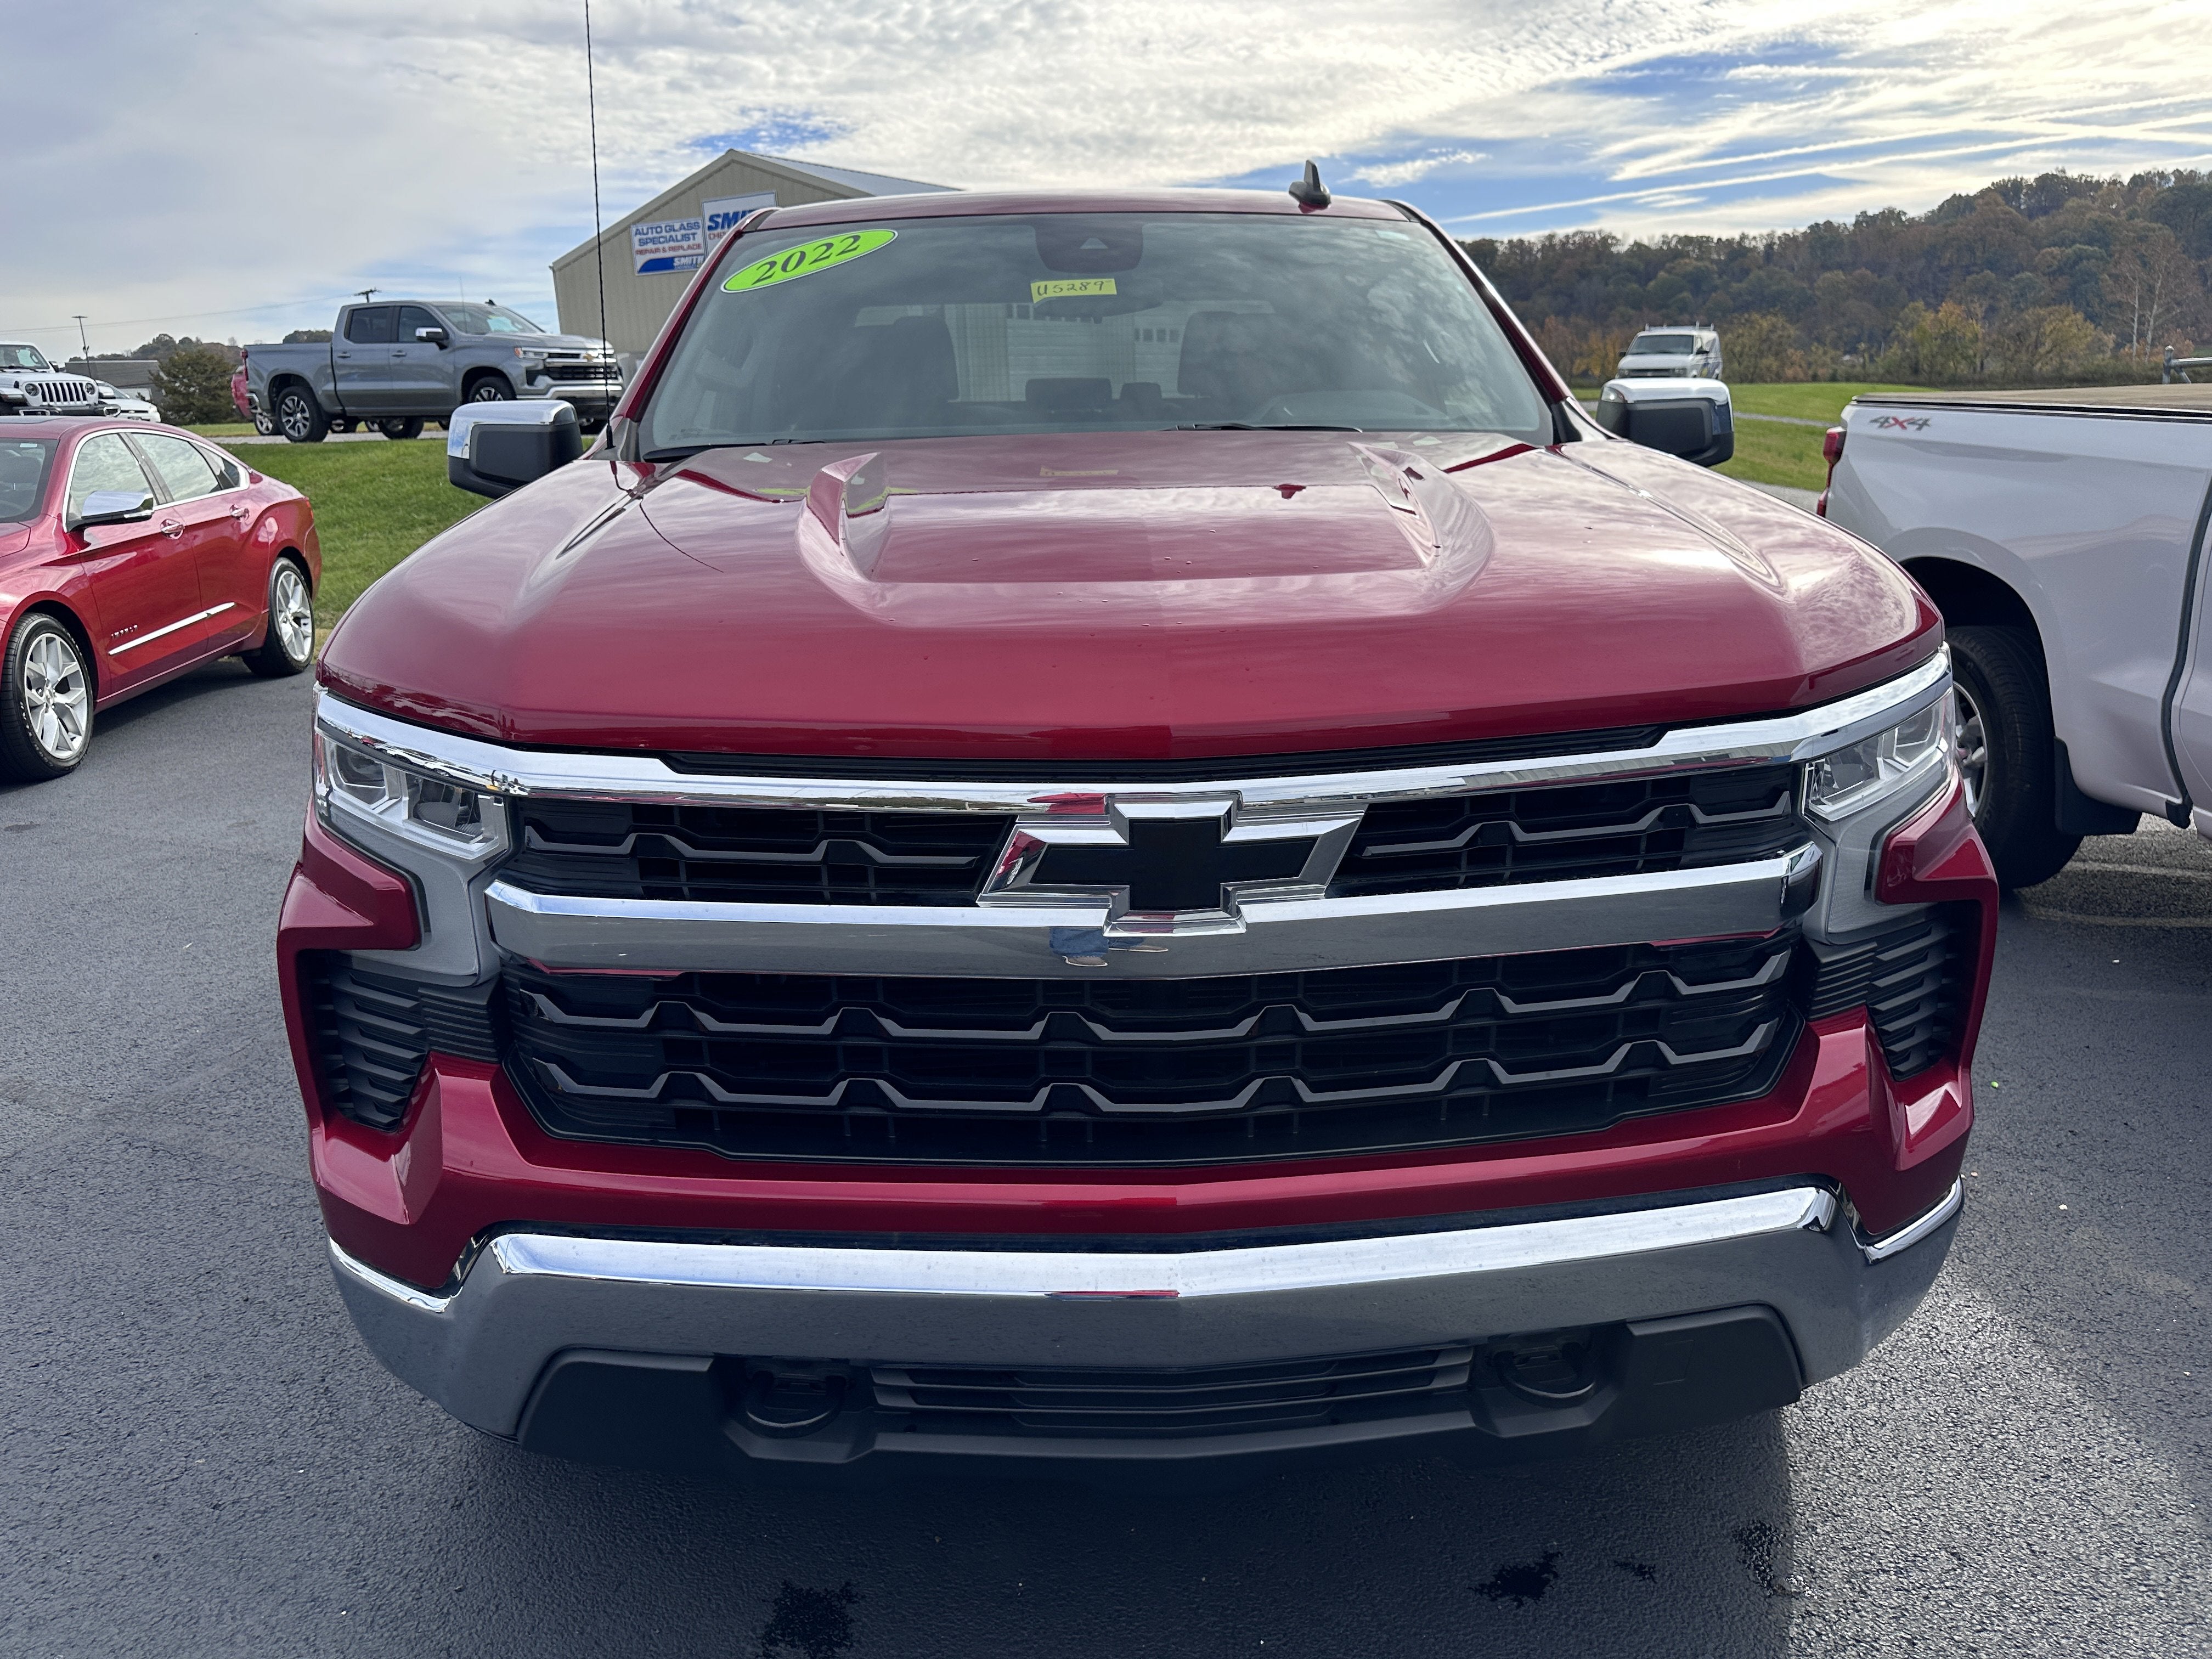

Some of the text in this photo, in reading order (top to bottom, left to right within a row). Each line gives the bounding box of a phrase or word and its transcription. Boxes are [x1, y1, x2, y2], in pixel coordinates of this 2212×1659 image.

[635, 222, 701, 236] AUTO GLASS
[639, 232, 697, 246] SPECIALIST
[636, 247, 661, 255] REPAIR
[668, 243, 702, 252] REPLACE
[751, 234, 861, 286] 2022
